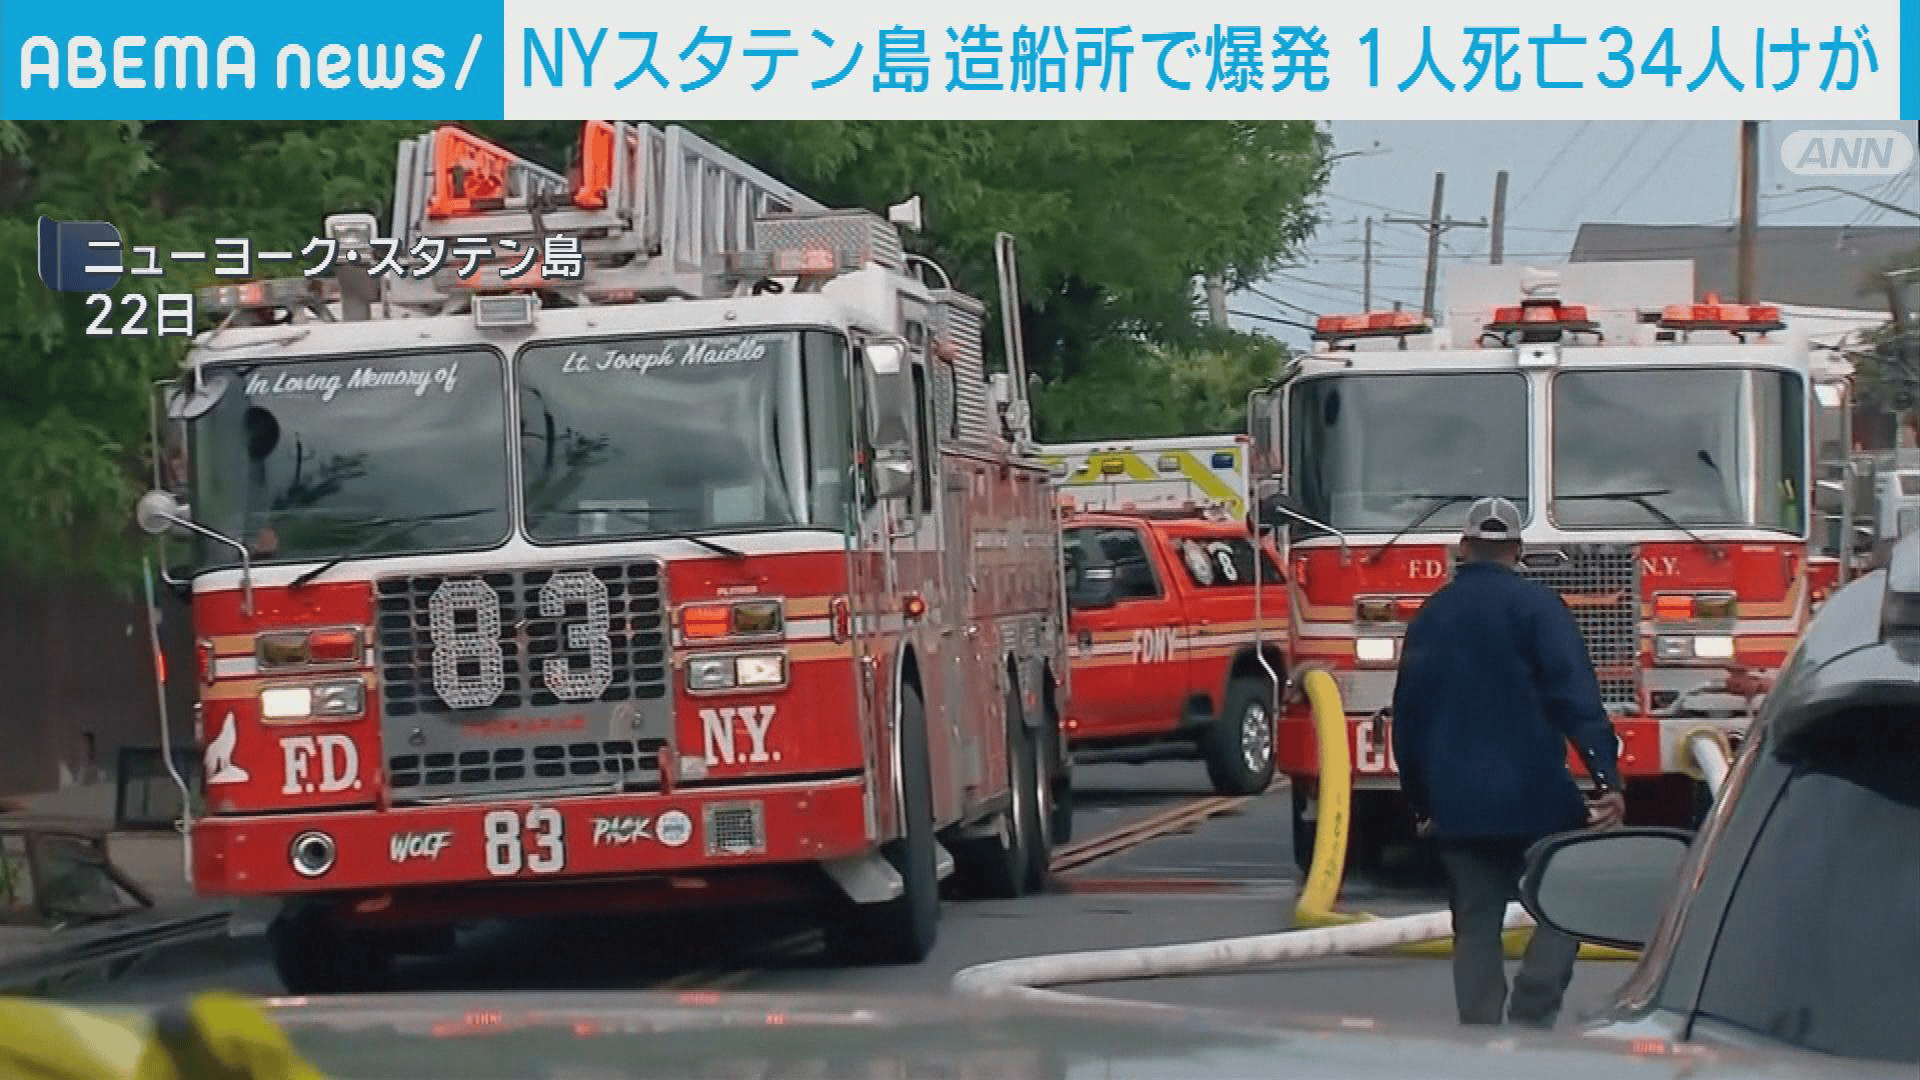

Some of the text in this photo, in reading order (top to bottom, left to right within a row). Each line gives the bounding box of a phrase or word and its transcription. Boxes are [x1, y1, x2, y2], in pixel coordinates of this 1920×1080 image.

[245, 360, 459, 402] In Loving Memory of
[596, 346, 676, 376] Joseph
[429, 570, 613, 709] 83
[1132, 627, 1177, 665] FDNY
[699, 704, 782, 767] N.Y.
[280, 735, 361, 795] F.D.
[389, 831, 453, 863] WOLF
[485, 808, 564, 875] 83
[592, 816, 652, 846] PACK
